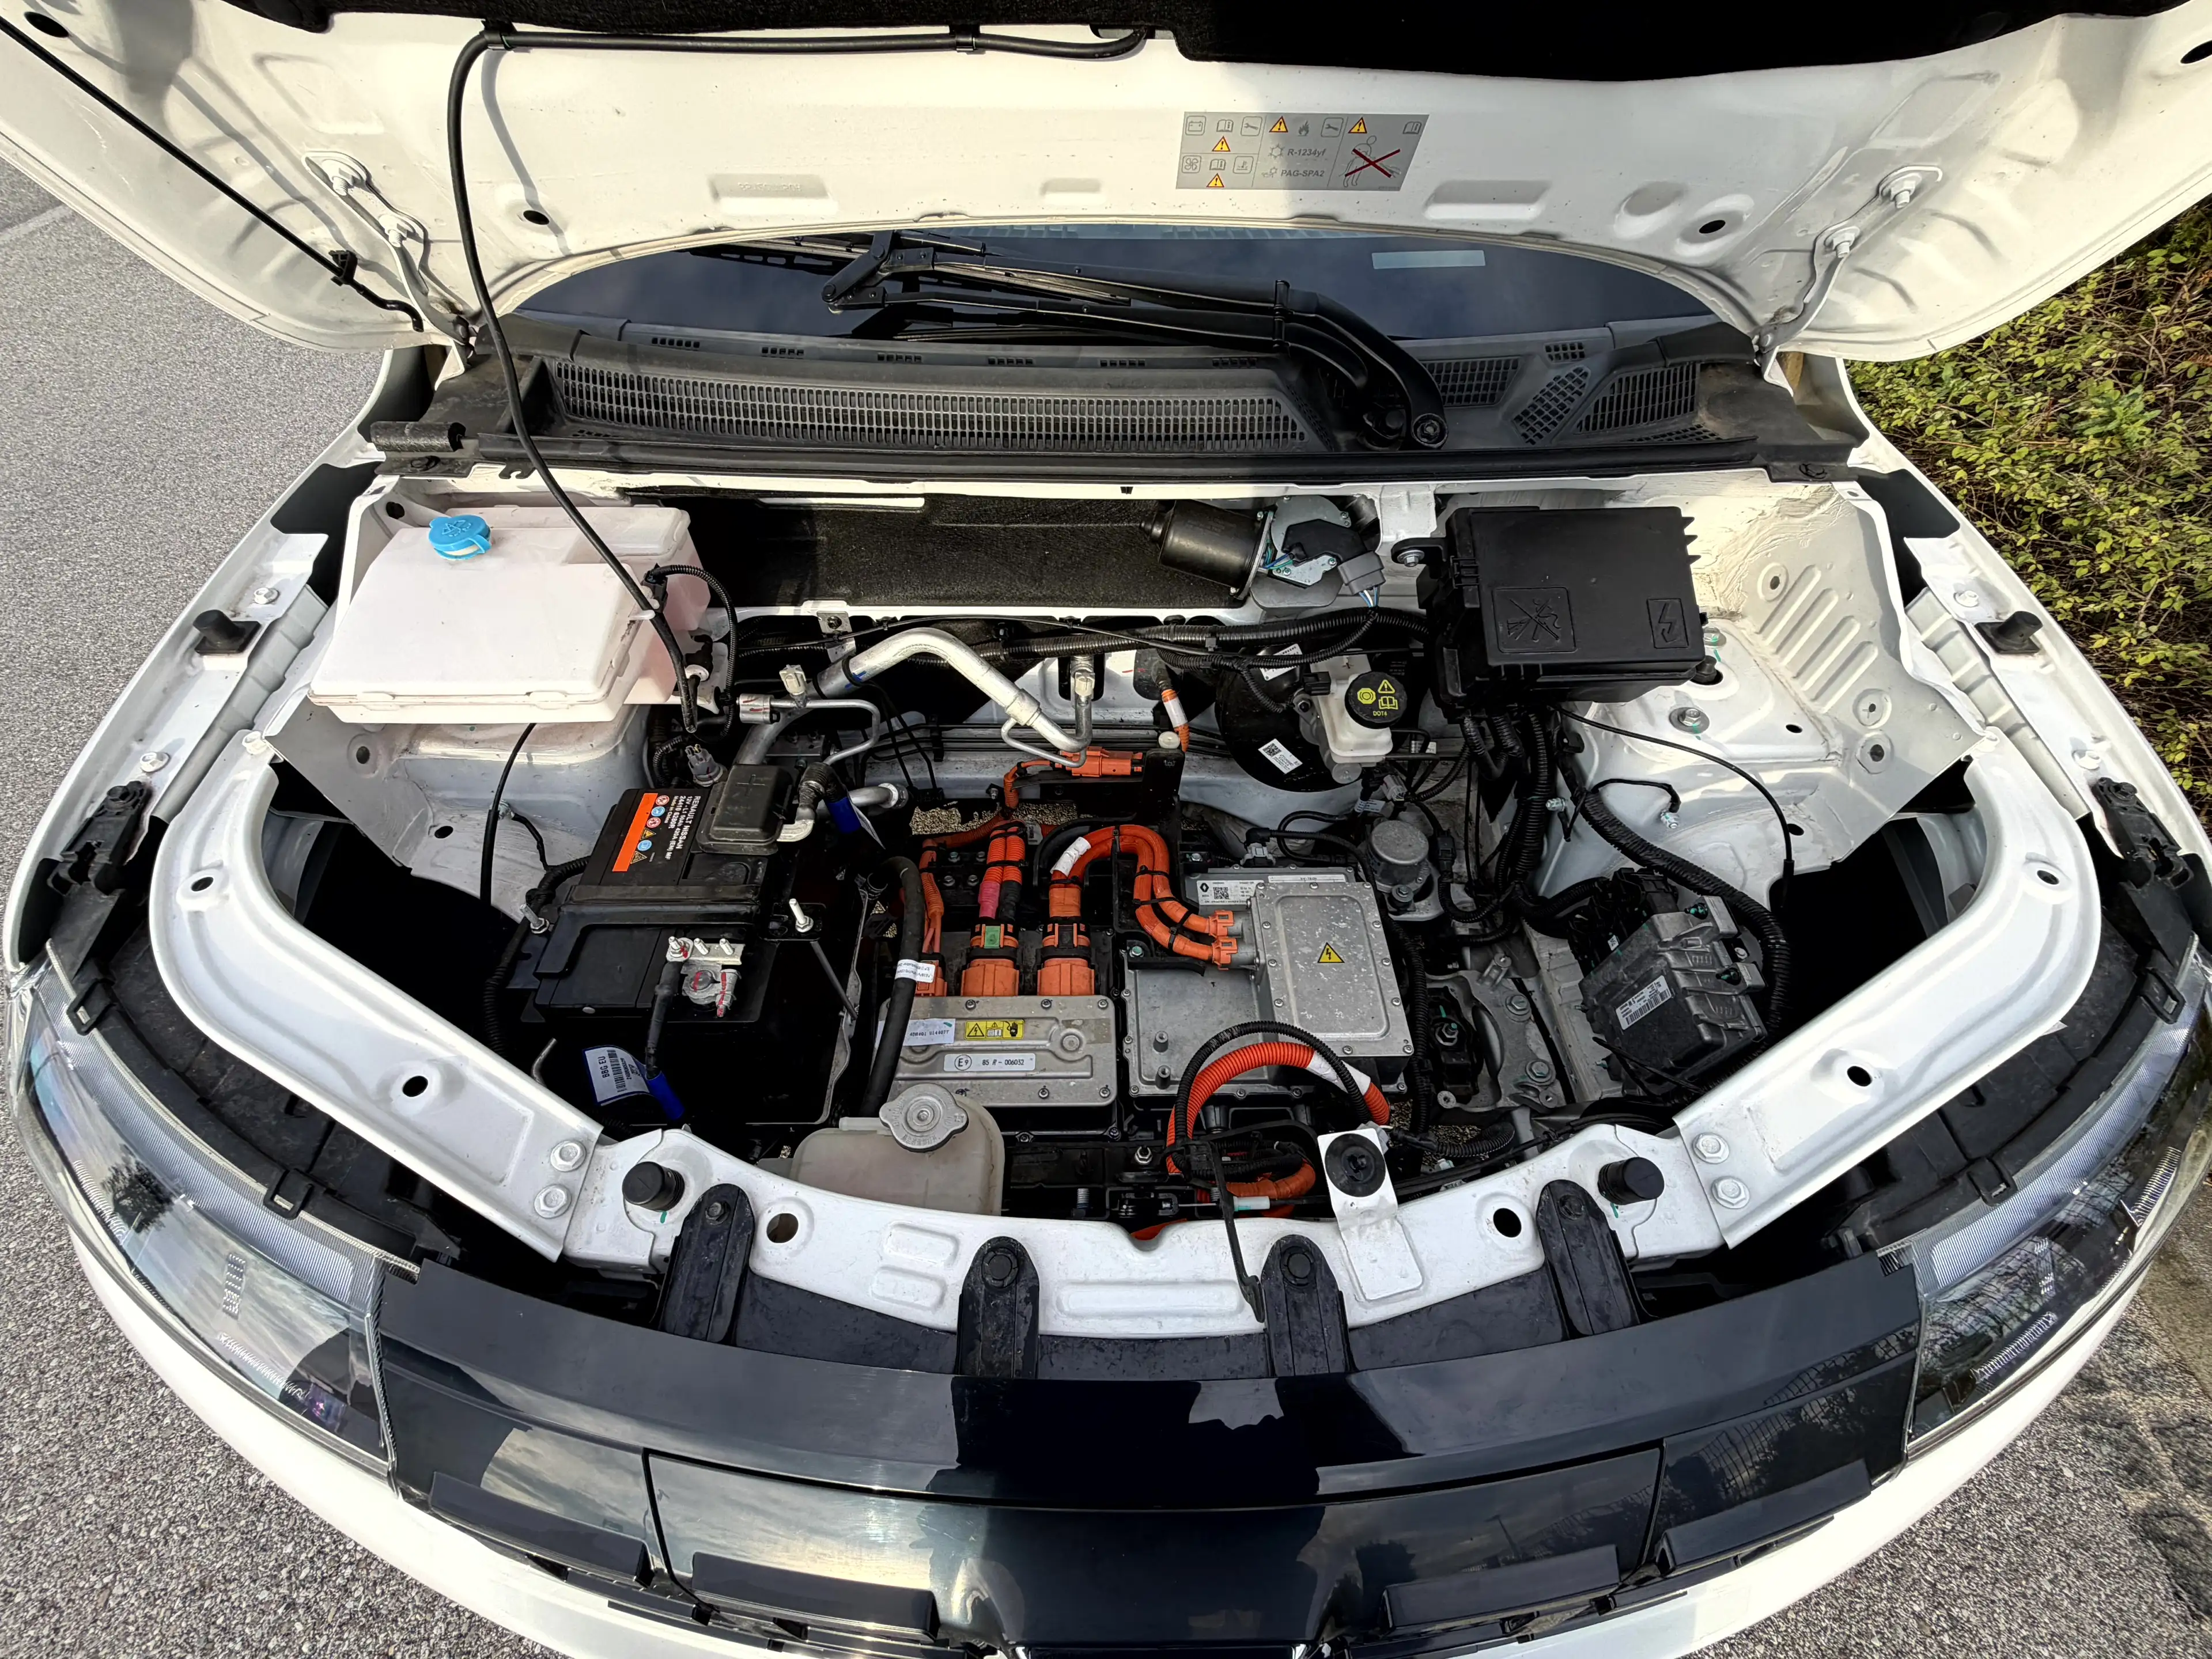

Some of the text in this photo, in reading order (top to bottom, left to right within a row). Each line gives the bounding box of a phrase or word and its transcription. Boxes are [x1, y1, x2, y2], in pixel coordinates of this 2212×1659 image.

[1287, 147, 1326, 157] R-1234yf
[668, 796, 686, 828] 24410 6280R
[675, 796, 701, 849] RENAULT NISSAN
[672, 828, 680, 840] 420A
[598, 1056, 610, 1078] BBG EU
